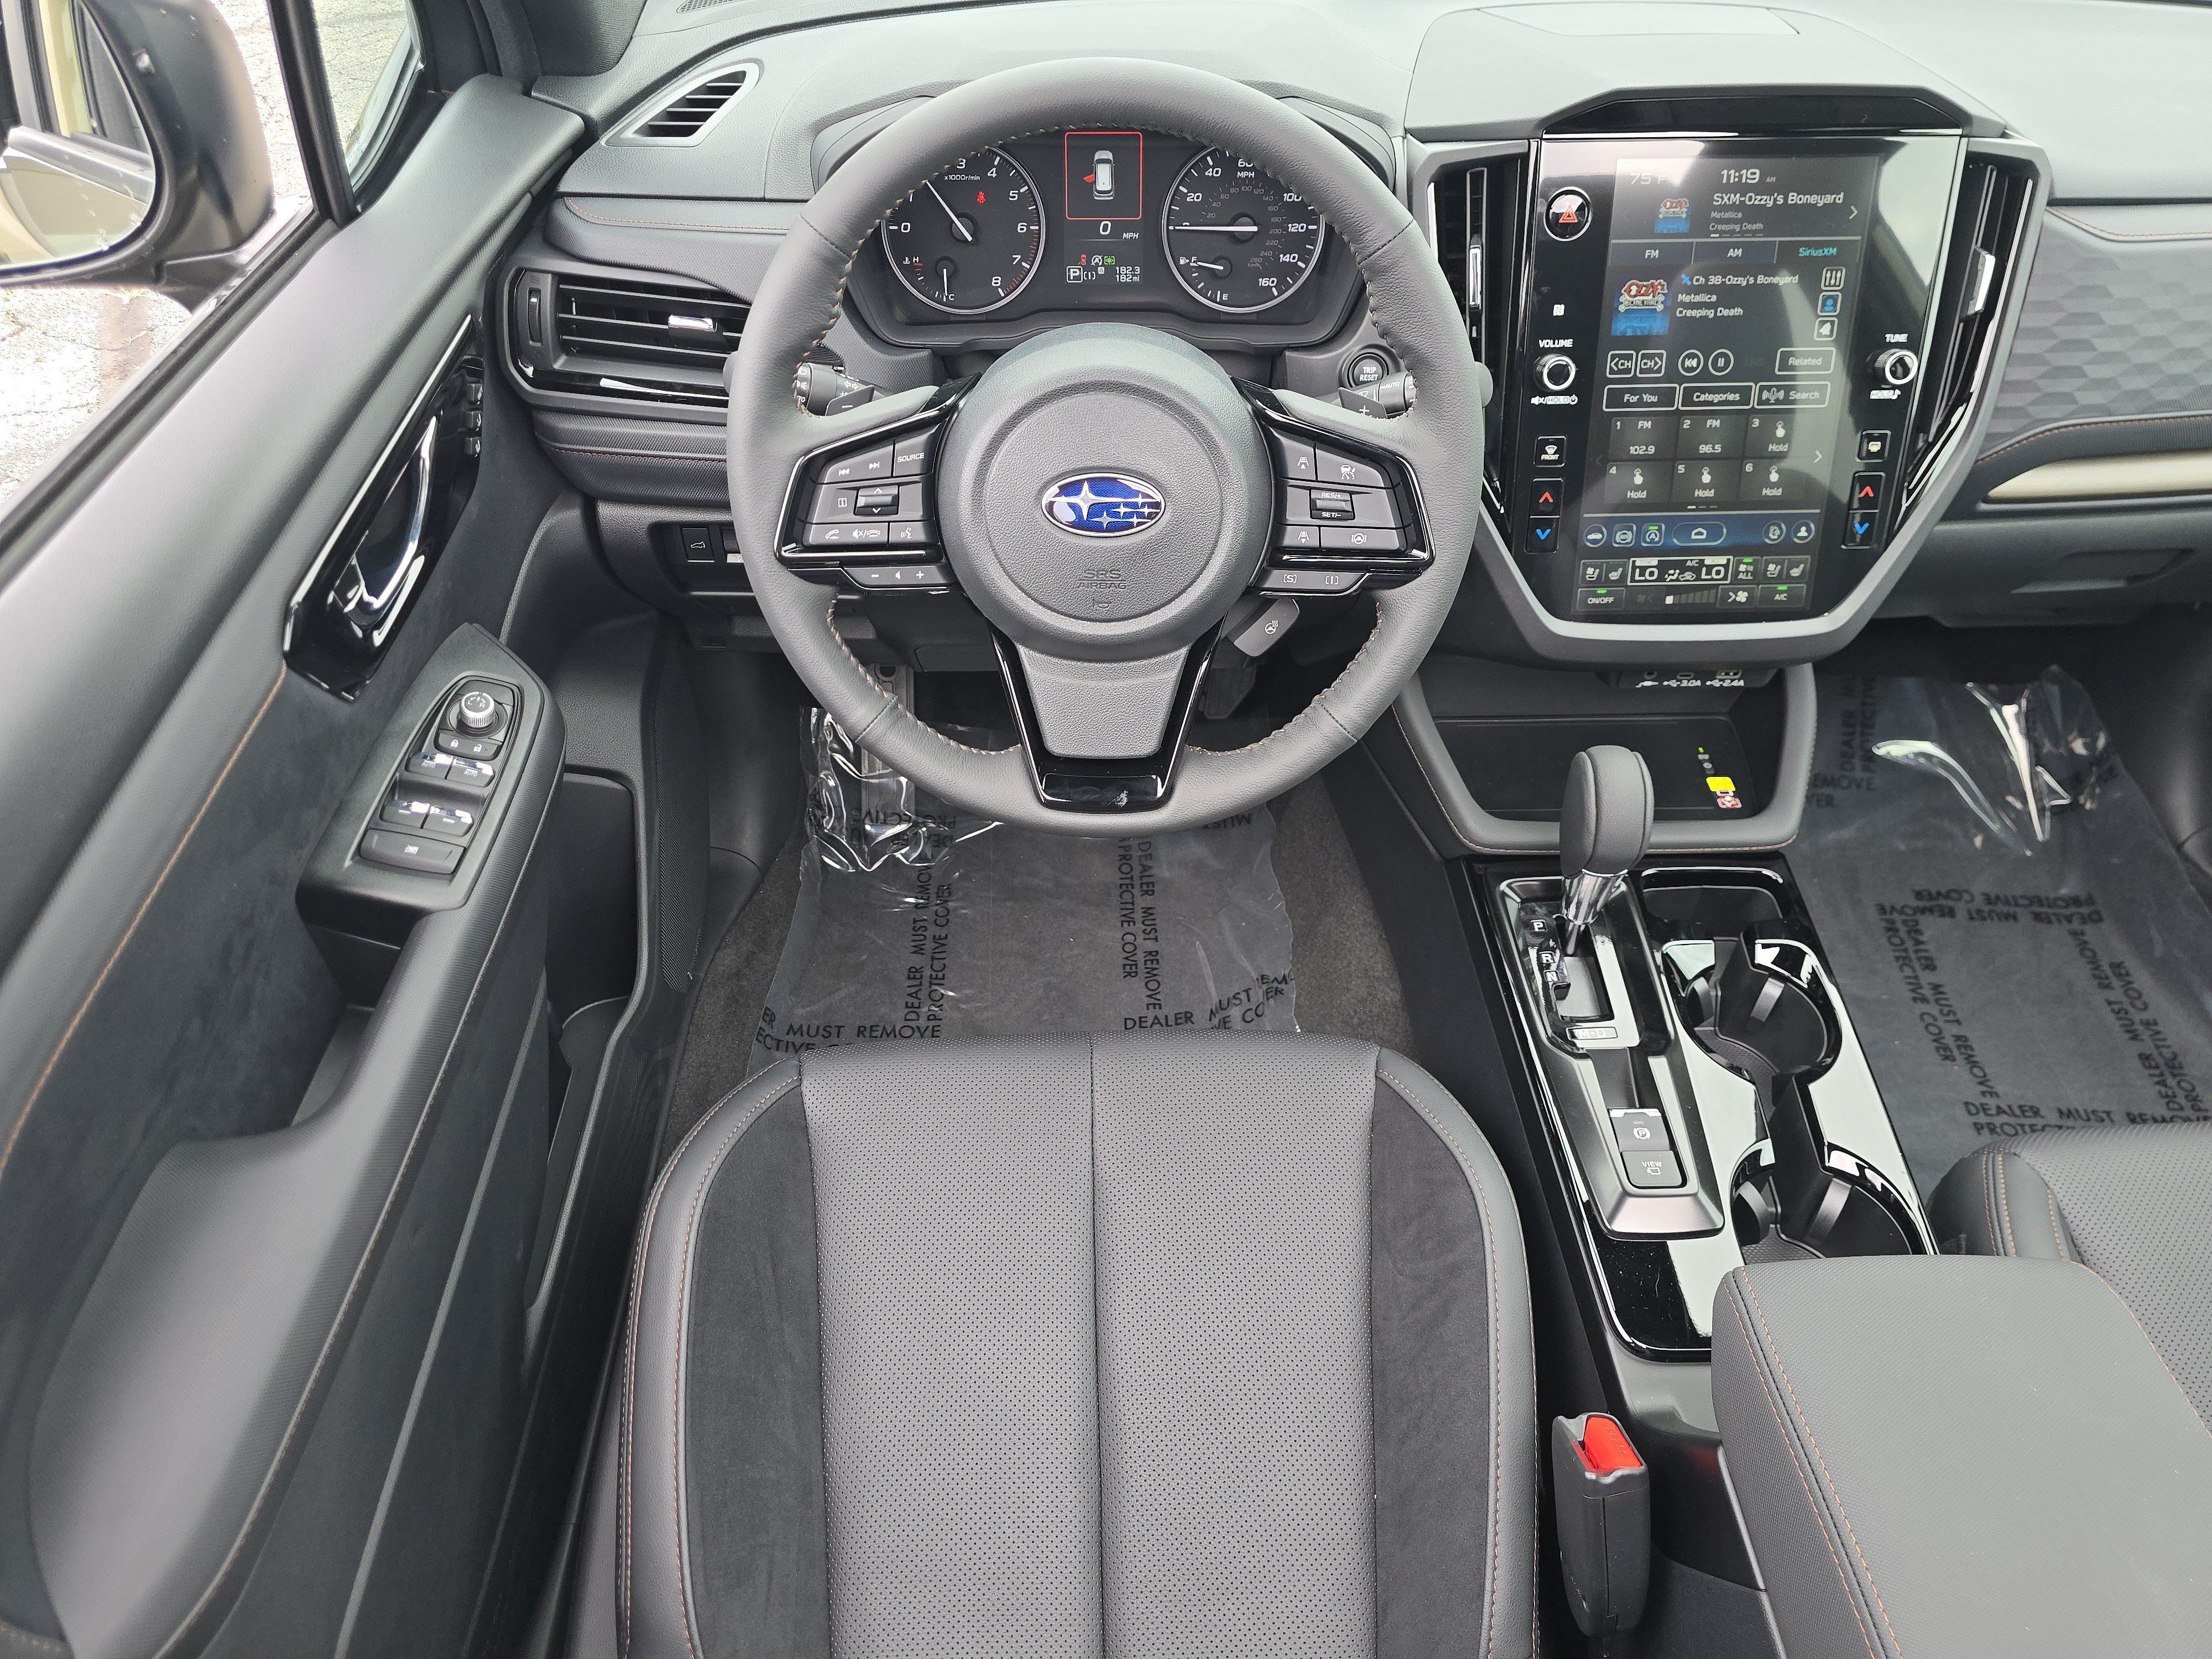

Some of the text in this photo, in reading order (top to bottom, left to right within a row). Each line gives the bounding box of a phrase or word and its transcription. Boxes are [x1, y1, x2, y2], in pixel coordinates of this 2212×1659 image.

[956, 159, 966, 169] 3
[987, 168, 997, 178] 4
[1205, 168, 1222, 177] 40
[1721, 169, 1760, 184] 11:19
[1009, 191, 1019, 201] 5
[1187, 193, 1202, 202] 20
[1284, 193, 1302, 201] 100
[1713, 192, 1844, 207] SXM-Ozzy's Boneyard
[901, 223, 911, 233] 0
[1017, 223, 1027, 233] 6
[1099, 221, 1112, 235] 0
[1287, 223, 1306, 232] 120
[1709, 222, 1740, 231] Creeping
[1645, 250, 1659, 259] FM
[1727, 248, 1742, 258] AM
[1798, 247, 1837, 257] SiriusXM
[1013, 255, 1021, 264] 7
[1280, 254, 1298, 262] 140
[1070, 269, 1080, 280] P
[992, 276, 1001, 286] 8
[1258, 278, 1277, 286] 160
[1693, 275, 1705, 285] Ch
[1756, 275, 1799, 286] Boneyard
[1677, 293, 1717, 302] Metallica
[1676, 307, 1744, 318] Creeping Death
[1885, 333, 1908, 342] TUNE
[1539, 339, 1573, 348] VOLUME
[1618, 360, 1632, 369] CH
[1641, 359, 1655, 368] CH
[1788, 357, 1822, 366] Related
[1624, 393, 1657, 402] For You
[1693, 392, 1740, 403] Categories
[1789, 390, 1820, 400] Search
[1616, 420, 1651, 430] 1 FM
[1683, 419, 1721, 428] 2 FM
[1751, 419, 1759, 427] 3
[1629, 445, 1655, 455] 102.9
[1699, 444, 1721, 453] 96.5
[1768, 442, 1788, 452] Hold
[897, 452, 925, 463] SOURCE
[1610, 466, 1617, 474] 4
[1678, 465, 1685, 473] 5
[1746, 463, 1753, 472] 6
[1627, 489, 1646, 499] Hold
[1694, 488, 1714, 497] Hold
[1762, 486, 1782, 497] Hold
[1083, 570, 1121, 579] SRS
[1635, 568, 1658, 580] LO
[1701, 566, 1725, 579] LO
[1117, 844, 1136, 928] PROTECTIVE
[1966, 907, 2019, 923] MUST
[1138, 840, 1163, 1011] DEALER MUST REMOVE
[904, 861, 933, 1021] DEALER MUST REMOV
[1121, 932, 1138, 978] COVER
[1542, 953, 1553, 963] R
[927, 933, 948, 1021] PROTECTIVE
[1546, 972, 1558, 981] N
[1880, 917, 1957, 1062] PROTECTIVE COVER
[2109, 961, 2148, 1012] COVER
[1124, 1011, 1194, 1030] DEALER
[2106, 998, 2145, 1042] MUST
[786, 1023, 941, 1039] MUST REMOVE
[1927, 981, 1963, 1026] MUST
[1950, 1034, 2001, 1099] REMOVE
[1964, 1100, 2044, 1119] DEALER
[2057, 1105, 2116, 1124] MUST
